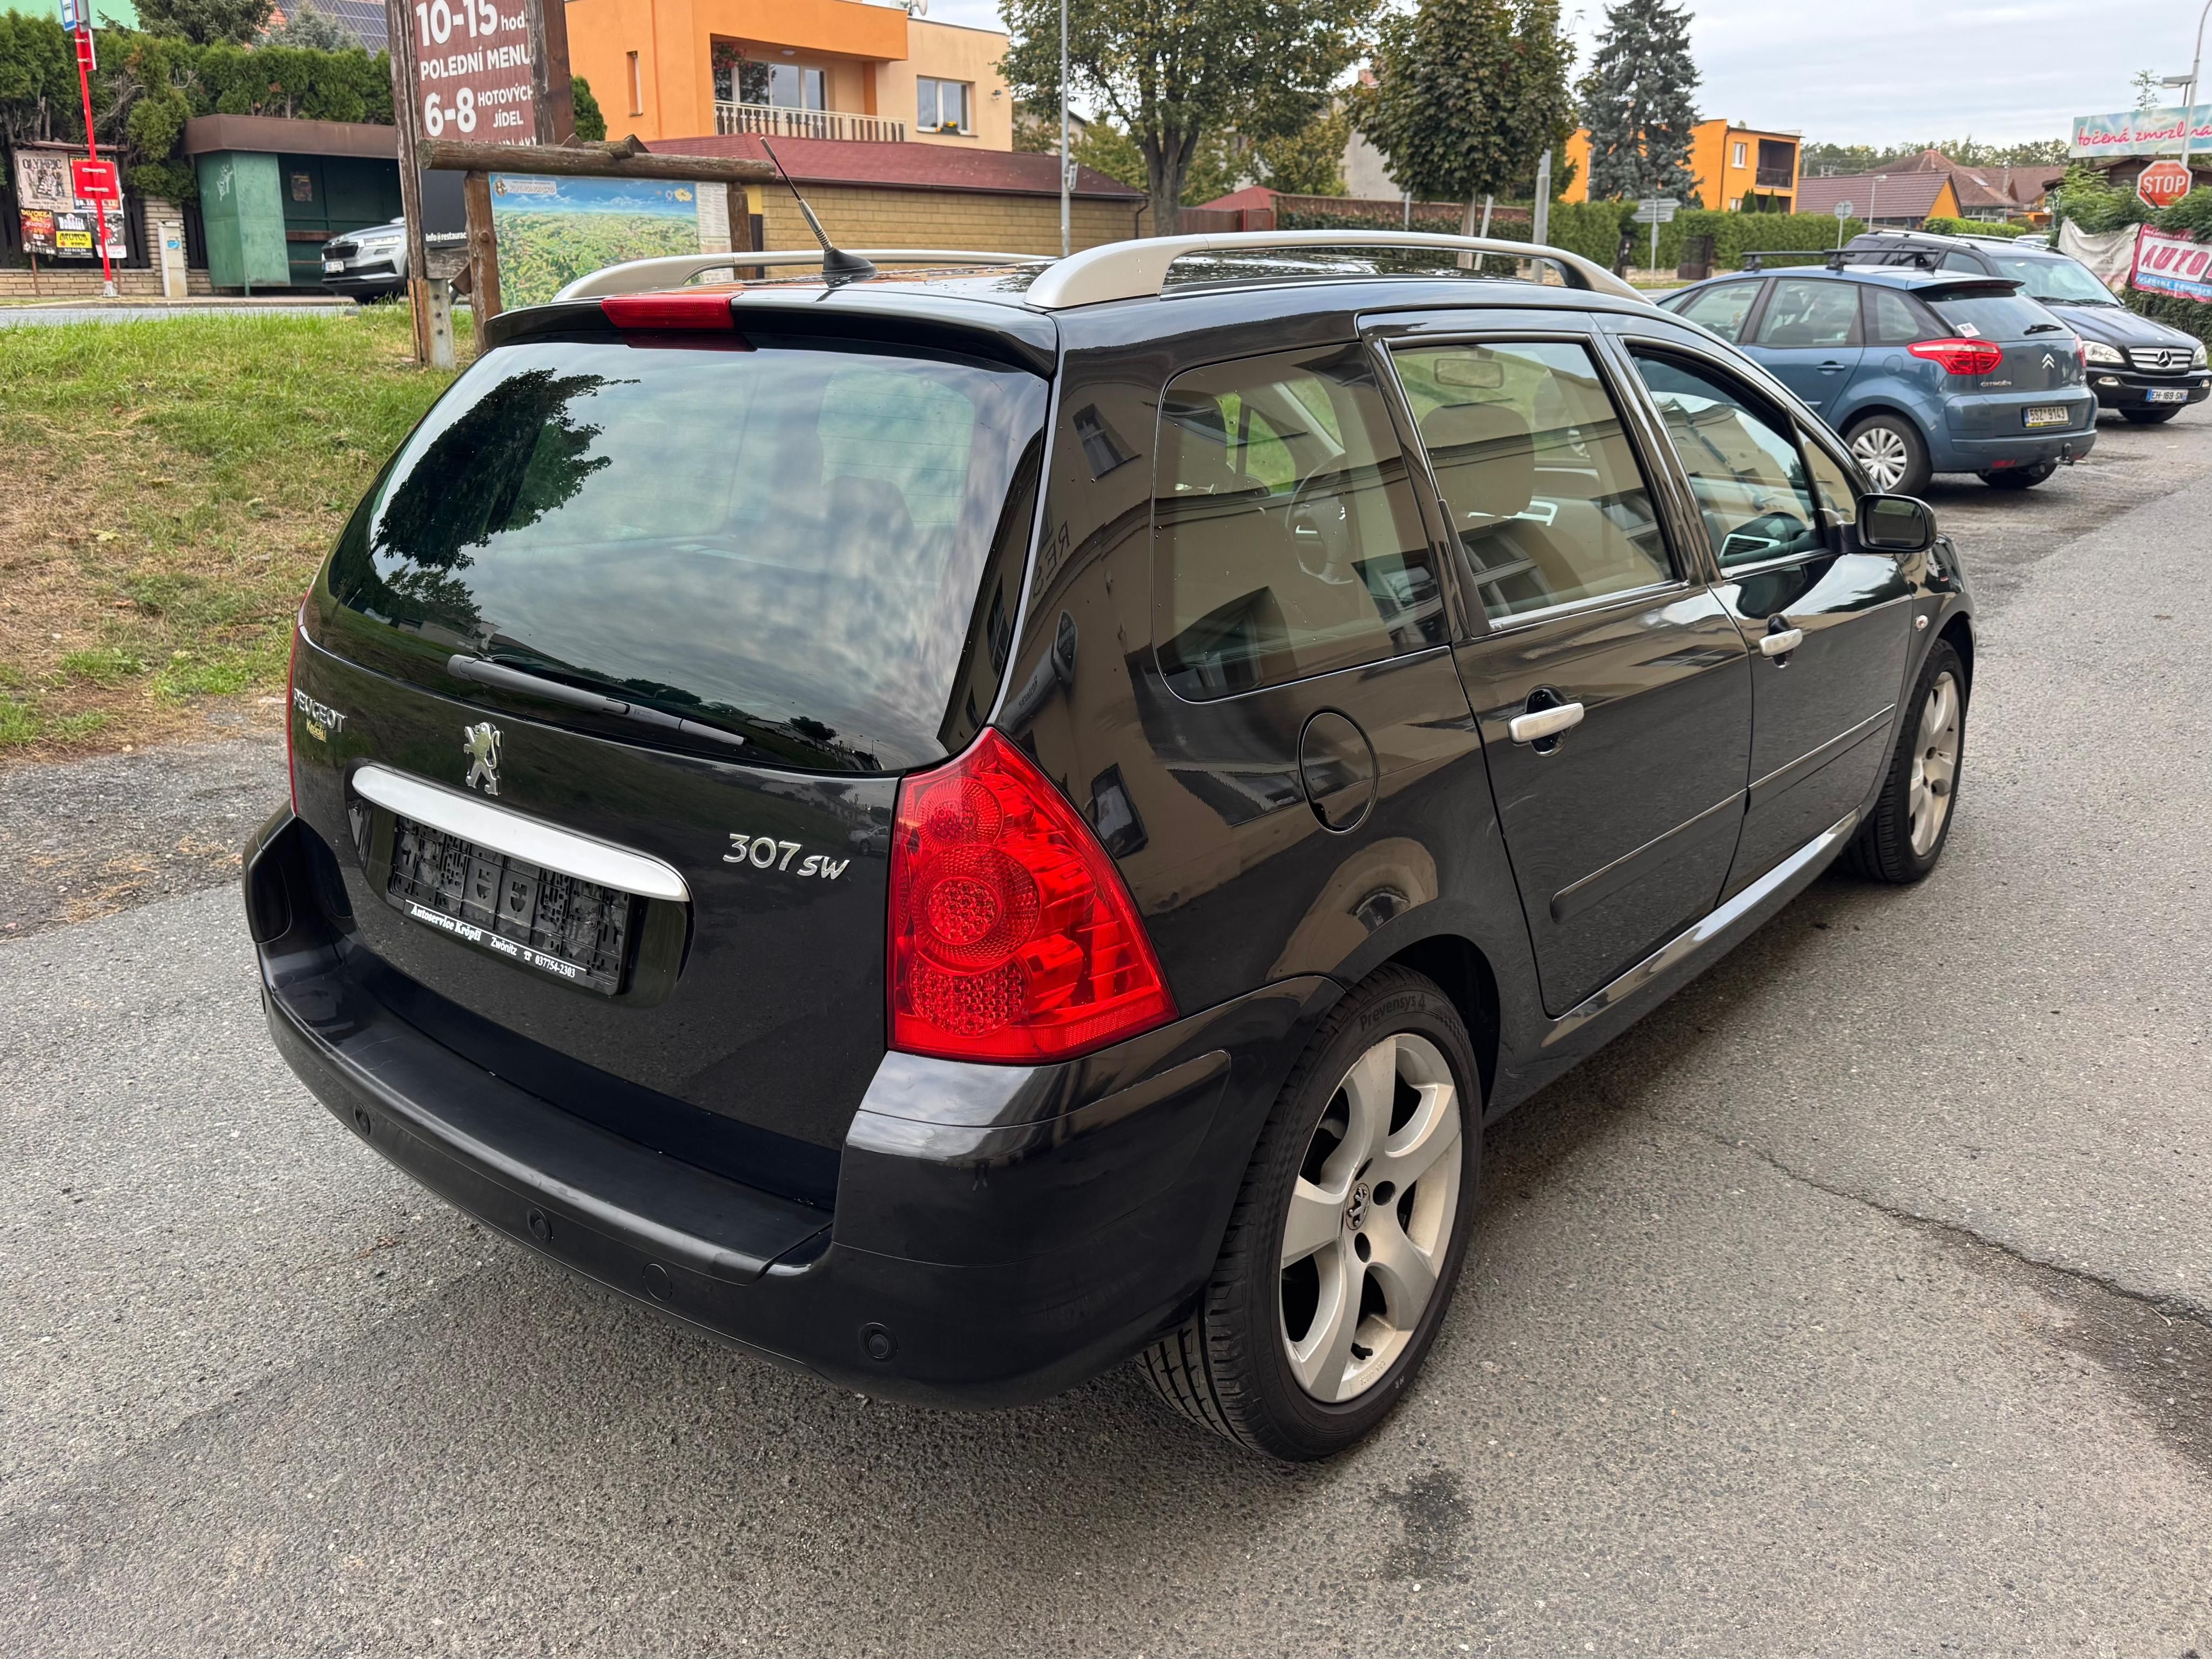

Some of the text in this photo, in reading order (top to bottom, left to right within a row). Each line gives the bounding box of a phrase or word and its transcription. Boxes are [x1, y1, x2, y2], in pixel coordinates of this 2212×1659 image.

[416, 0, 497, 46] 10-15
[420, 43, 531, 81] POLEDNÍ MENU
[424, 87, 477, 137] 6-8
[493, 109, 524, 128] JÍDEL
[2077, 120, 2212, 146] točená zmrzlna
[22, 158, 63, 170] OLYMPIC
[2143, 174, 2186, 194] STOP
[2141, 245, 2209, 276] AUTO
[294, 687, 348, 733] PEUGEOT
[722, 833, 802, 871] 307
[411, 905, 576, 978] Autoservice Kröpfl Zwönitz 037754-2303
[1360, 994, 1426, 1032] Prevensys 4
